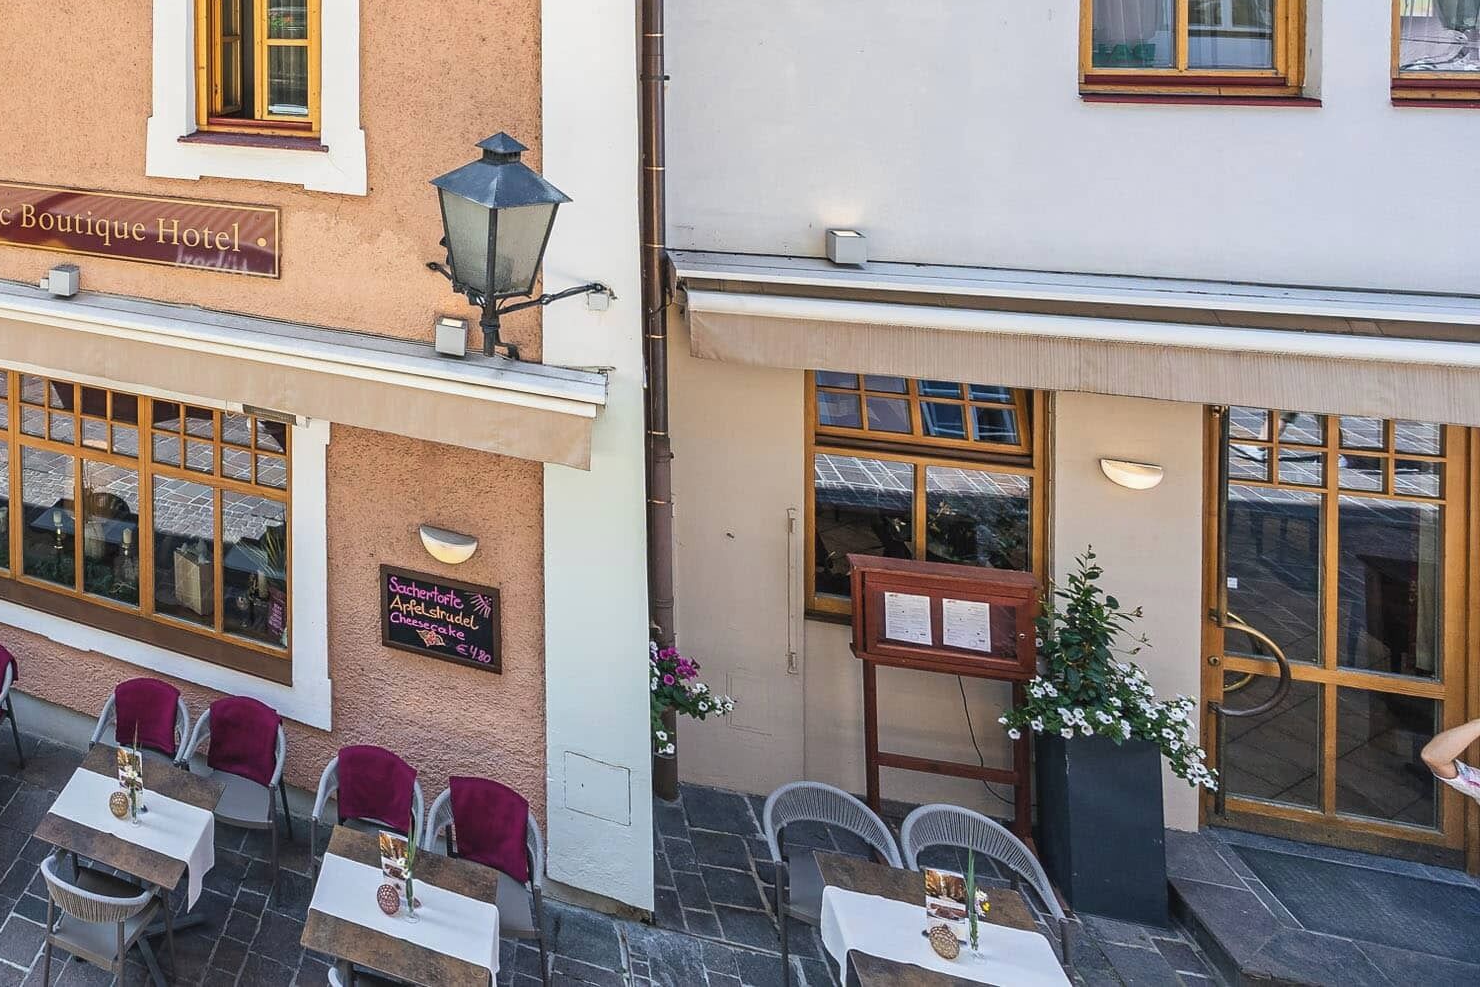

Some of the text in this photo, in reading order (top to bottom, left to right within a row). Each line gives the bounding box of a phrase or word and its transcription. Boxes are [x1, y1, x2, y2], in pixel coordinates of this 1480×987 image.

[20, 203, 146, 247] Boutique
[155, 217, 241, 252] Hotel
[388, 576, 465, 609] Sachertorte
[389, 594, 480, 631] Apfelstrudel
[390, 611, 466, 641] Cheesecake
